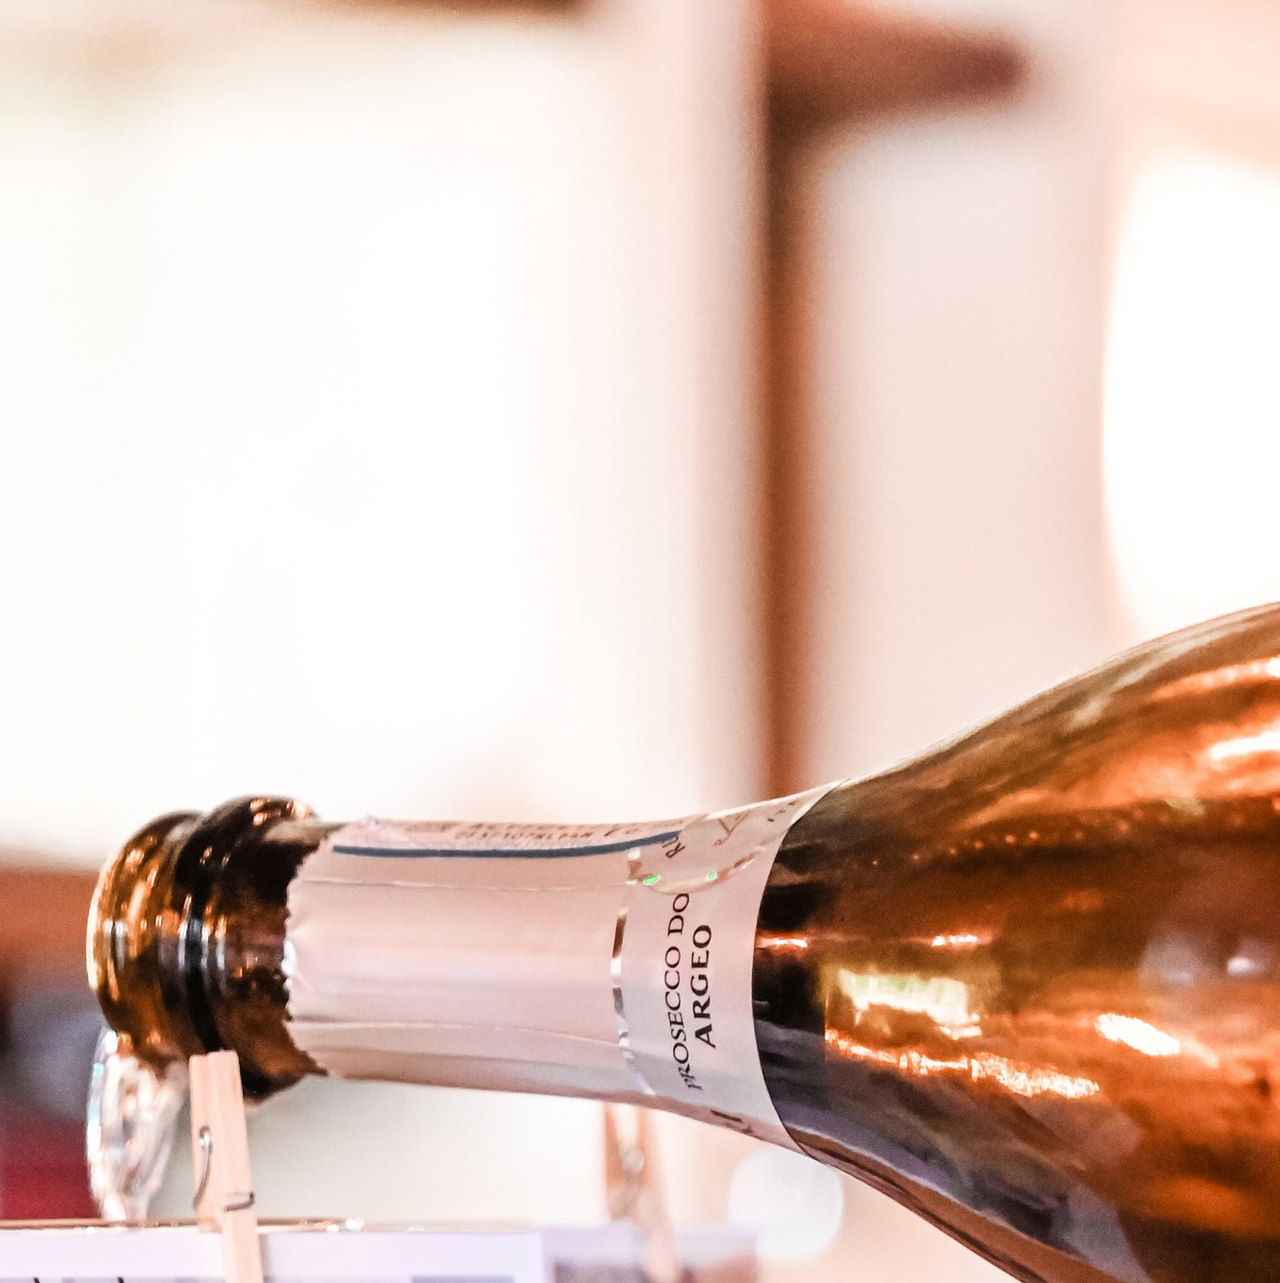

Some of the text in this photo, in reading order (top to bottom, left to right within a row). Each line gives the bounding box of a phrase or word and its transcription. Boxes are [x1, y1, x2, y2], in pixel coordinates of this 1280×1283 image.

[664, 892, 703, 1092] PROSECCO DO
[690, 925, 717, 1050] ARGEO
